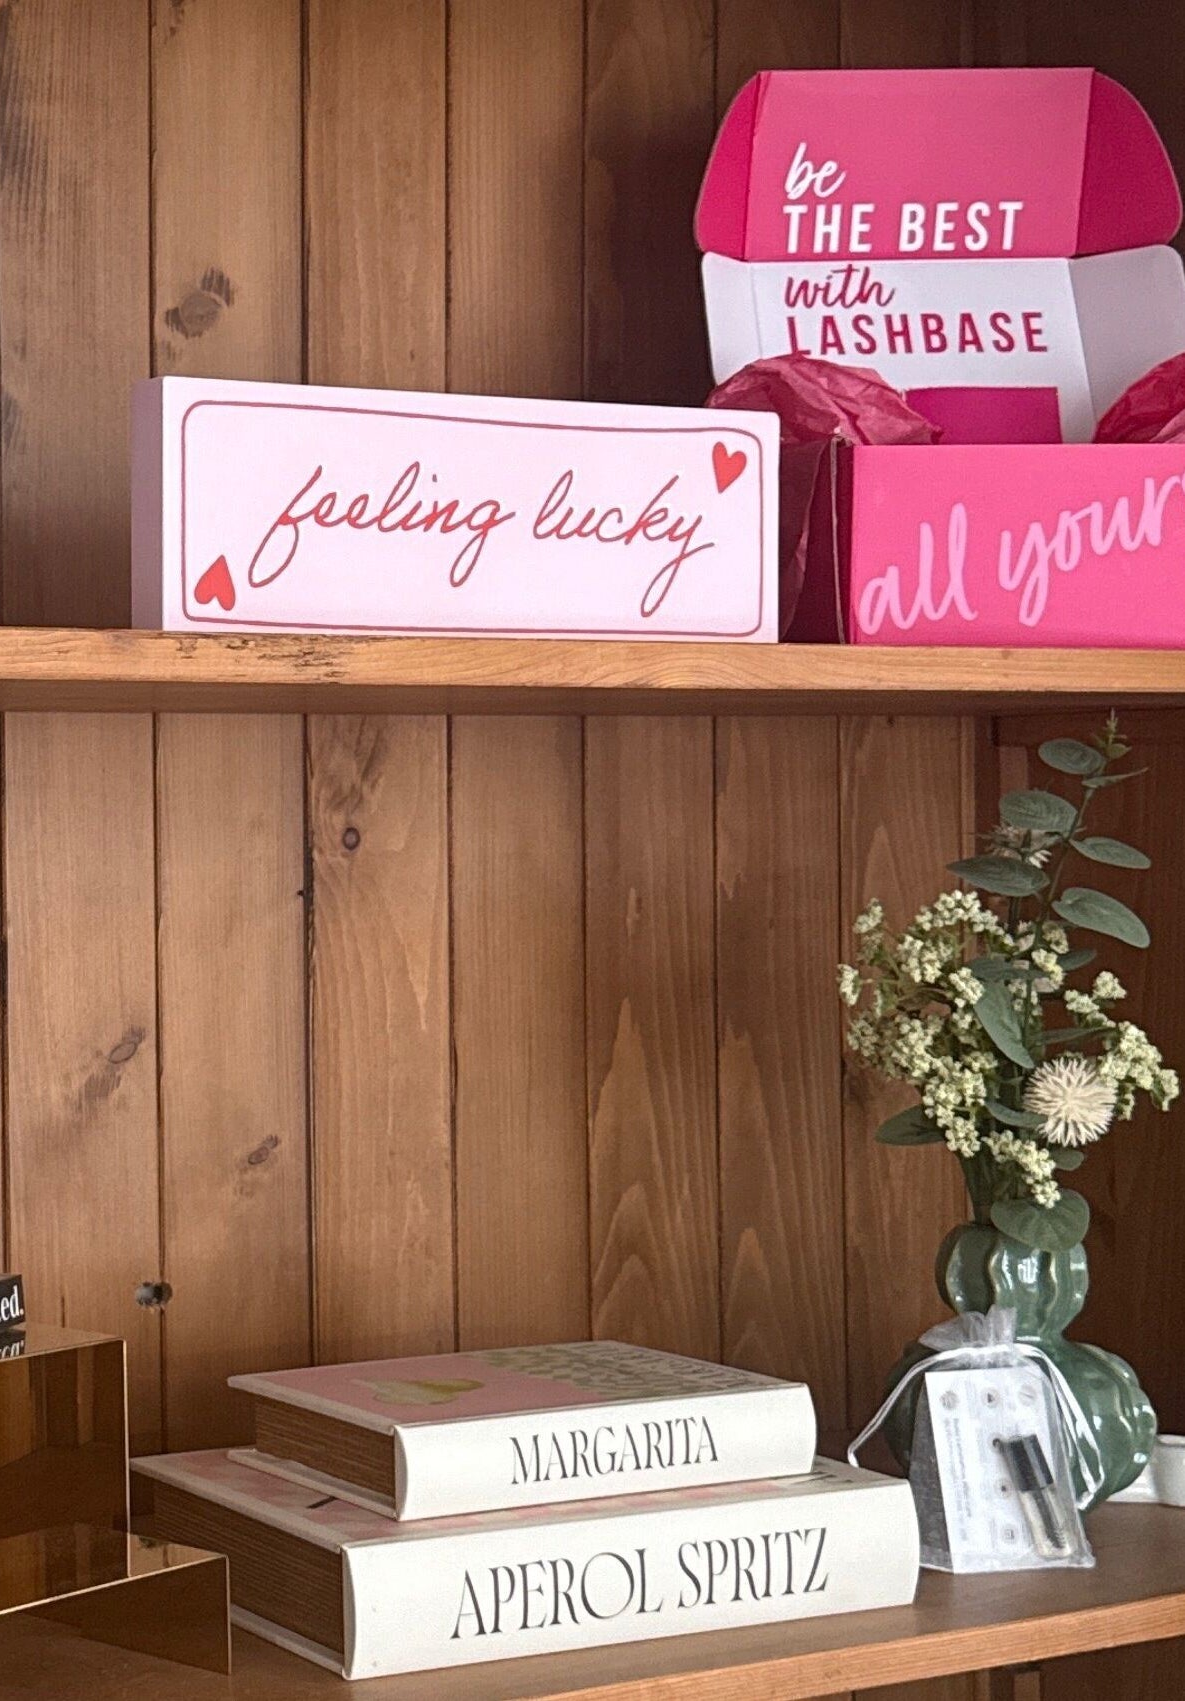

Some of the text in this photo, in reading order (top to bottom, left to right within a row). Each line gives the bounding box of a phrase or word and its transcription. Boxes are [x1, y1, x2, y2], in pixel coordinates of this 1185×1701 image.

[785, 142, 846, 199] be
[783, 201, 1024, 254] THE BEST
[784, 264, 896, 309] with
[787, 312, 1049, 356] LASHBASE
[248, 461, 715, 618] feeling lucky
[858, 469, 1185, 635] all your
[509, 1415, 719, 1485] MARGARITA
[450, 1527, 830, 1640] APEROL SPRITZ
